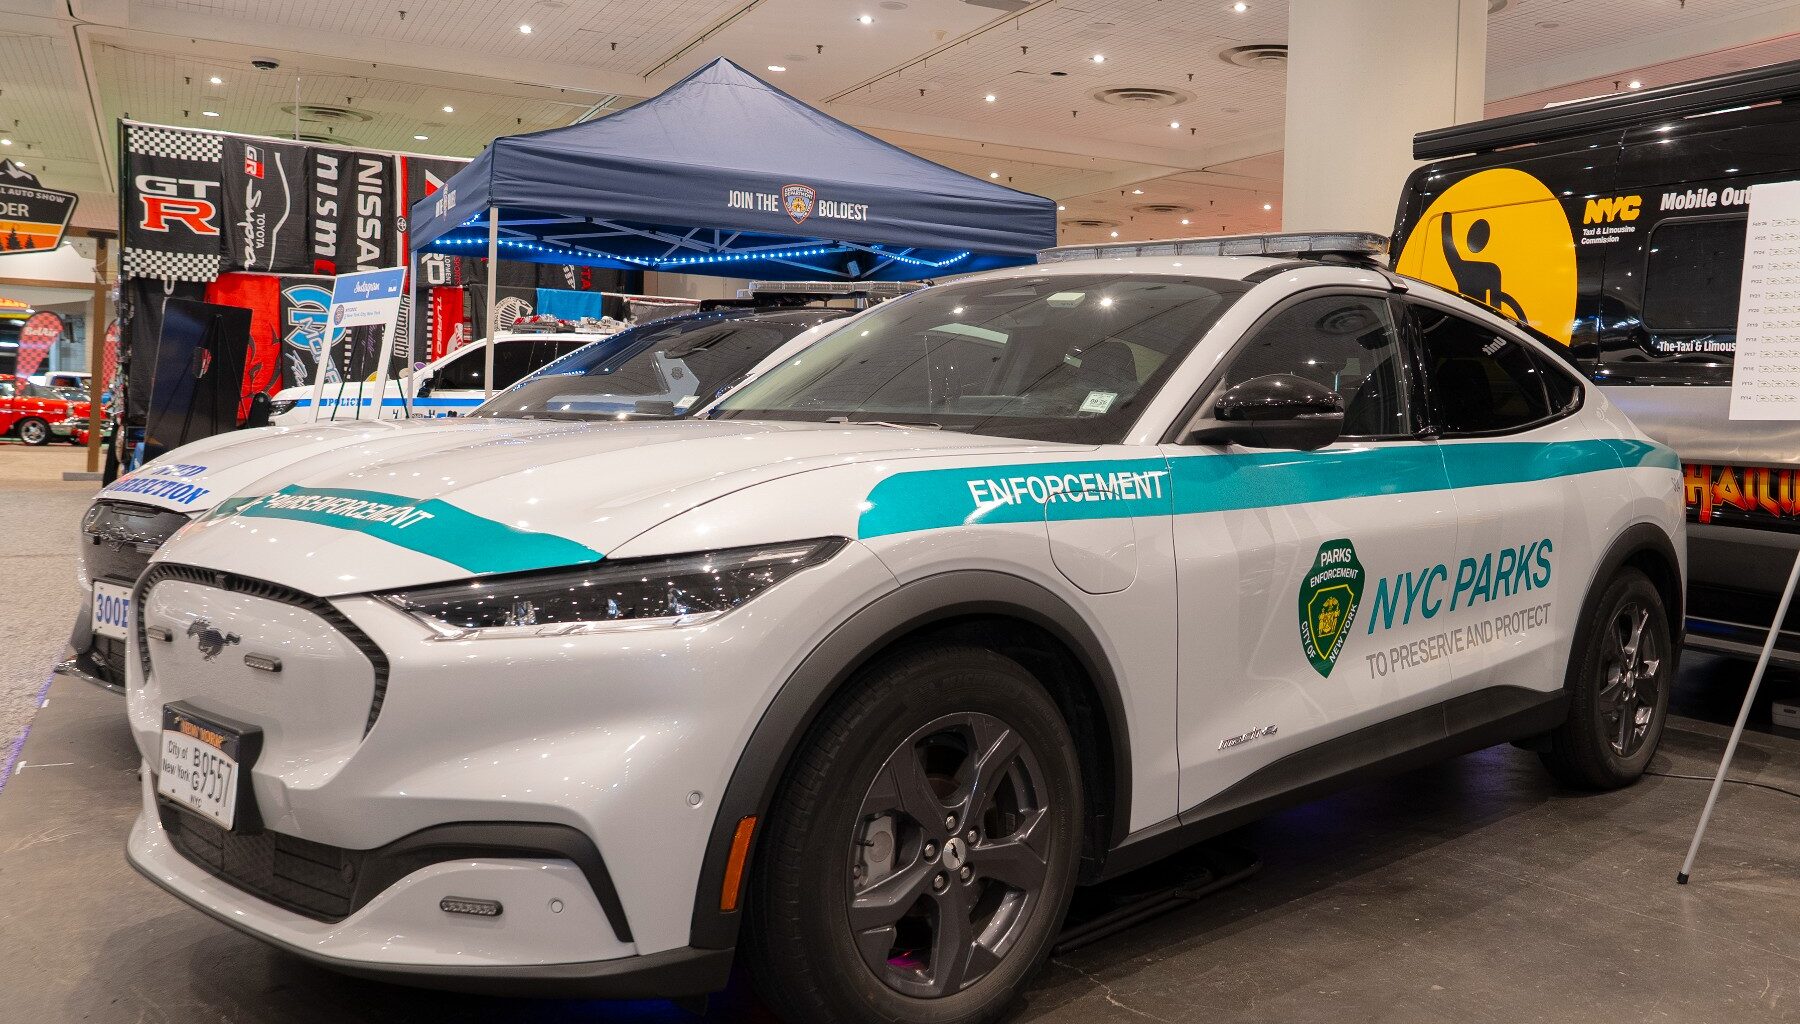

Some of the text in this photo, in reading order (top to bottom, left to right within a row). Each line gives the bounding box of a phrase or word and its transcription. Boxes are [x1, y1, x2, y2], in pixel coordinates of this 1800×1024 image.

[9, 188, 34, 198] AUTO
[36, 192, 66, 204] SHOW
[135, 175, 220, 198] GT
[1660, 188, 1717, 211] Mobile
[139, 193, 220, 235] R
[728, 190, 752, 210] JOIN
[756, 193, 778, 212] THE
[819, 200, 868, 221] BOLDEST
[1583, 195, 1642, 224] NYC
[256, 213, 265, 249] TOYOTA
[1583, 228, 1595, 236] Taxi
[1602, 225, 1636, 235] Limousine
[1660, 341, 1674, 352] The
[1676, 341, 1693, 352] Taxi
[1695, 340, 1702, 352] &
[967, 471, 1167, 508] ENFORCEMENT
[1320, 548, 1352, 567] PARKS
[1310, 567, 1359, 588] ENFORCEMENT
[1367, 538, 1553, 635] NYC PARKS
[1301, 620, 1316, 659] CITY OF
[1329, 604, 1358, 663] NEW YORK
[1365, 603, 1552, 679] TO PRESERVE AND PROTECT
[168, 740, 189, 760] City of
[163, 758, 191, 782] New York
[201, 751, 232, 808] 9557
